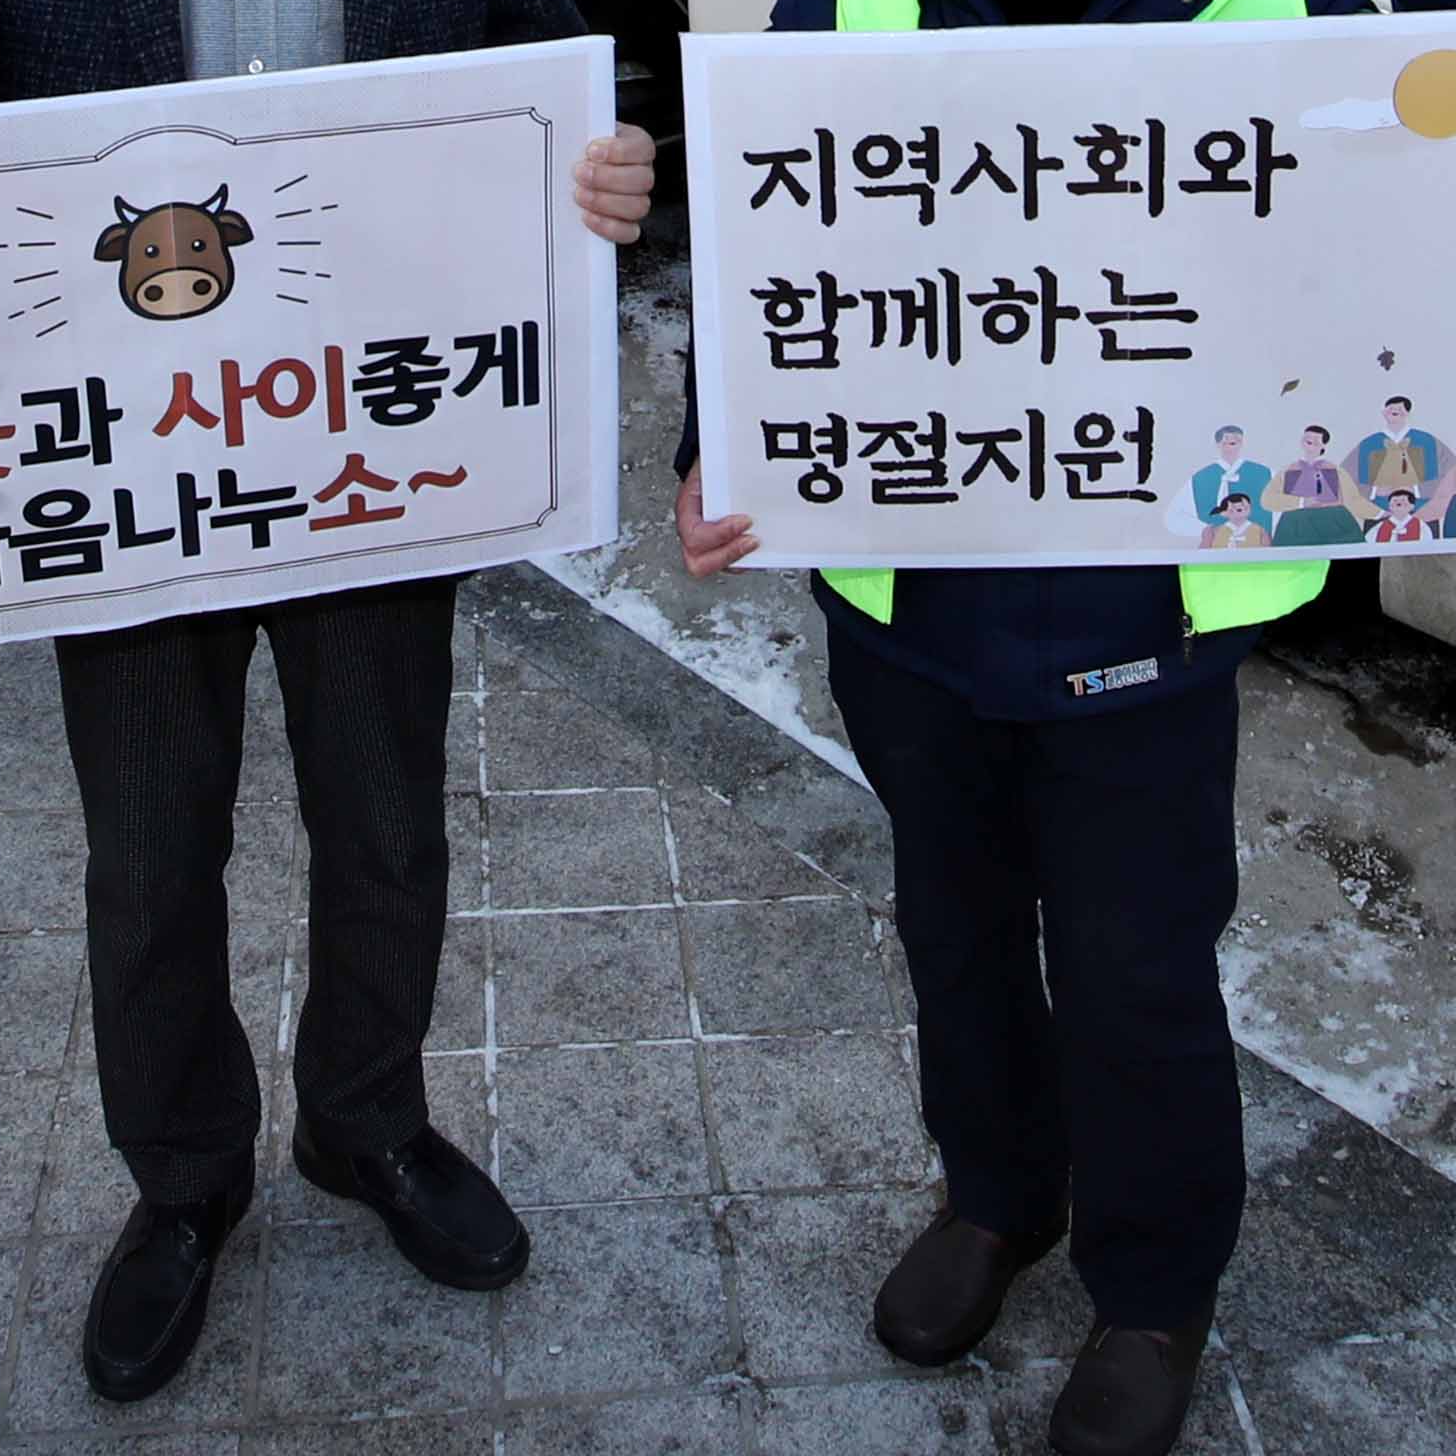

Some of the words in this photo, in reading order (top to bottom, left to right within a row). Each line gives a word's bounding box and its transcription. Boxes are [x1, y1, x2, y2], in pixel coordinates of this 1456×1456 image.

[743, 117, 1299, 227] 지역사회와
[750, 264, 1200, 371] 함께하는
[152, 320, 543, 449] 사이좋게
[761, 405, 1159, 505] 명절지원
[1066, 669, 1104, 696] TS
